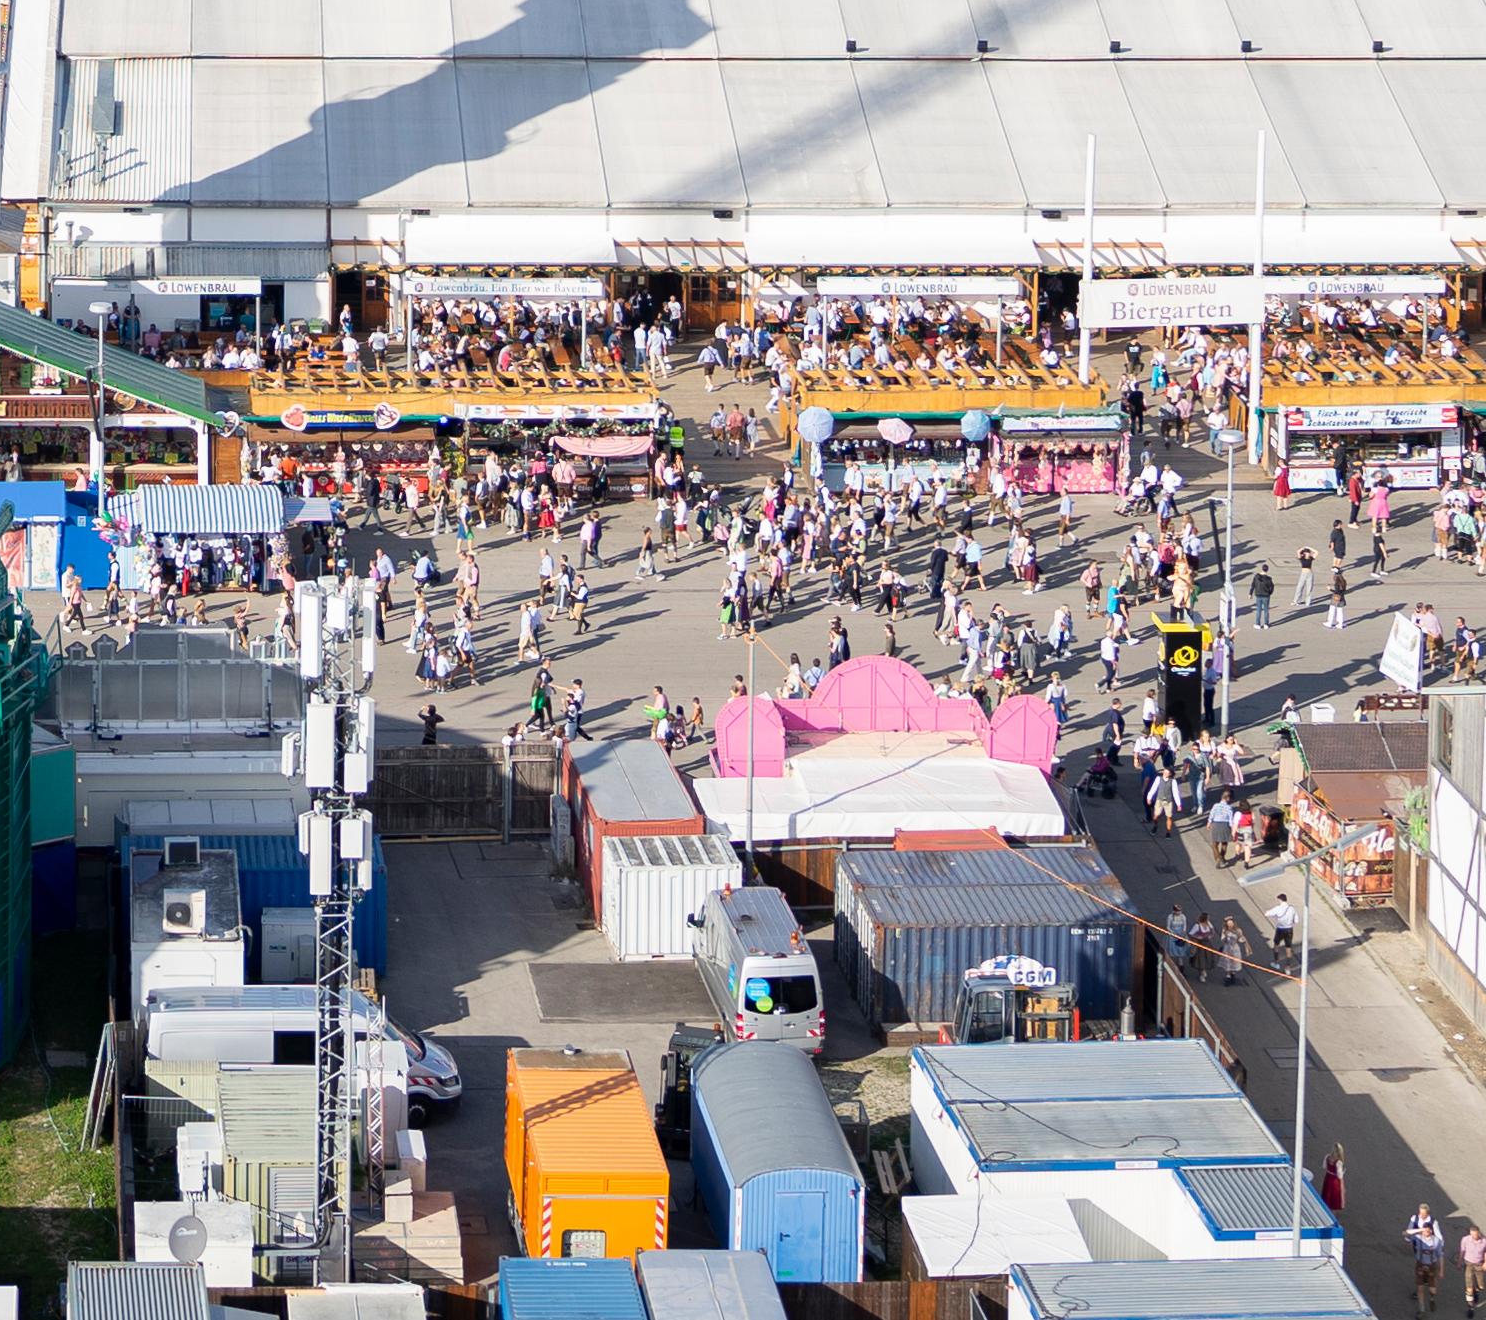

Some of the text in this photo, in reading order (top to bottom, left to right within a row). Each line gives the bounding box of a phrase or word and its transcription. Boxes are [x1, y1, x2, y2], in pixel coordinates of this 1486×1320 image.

[171, 281, 236, 293] LÖWENBRÄU
[430, 282, 488, 294] Löwenbräu.
[894, 281, 957, 293] LÖWENBRÄU
[1142, 282, 1217, 296] LÖWENBRÄU
[1320, 280, 1384, 293] LÖWENBRÄU
[1111, 299, 1233, 325] Biergarten
[1014, 969, 1052, 984] CGM
